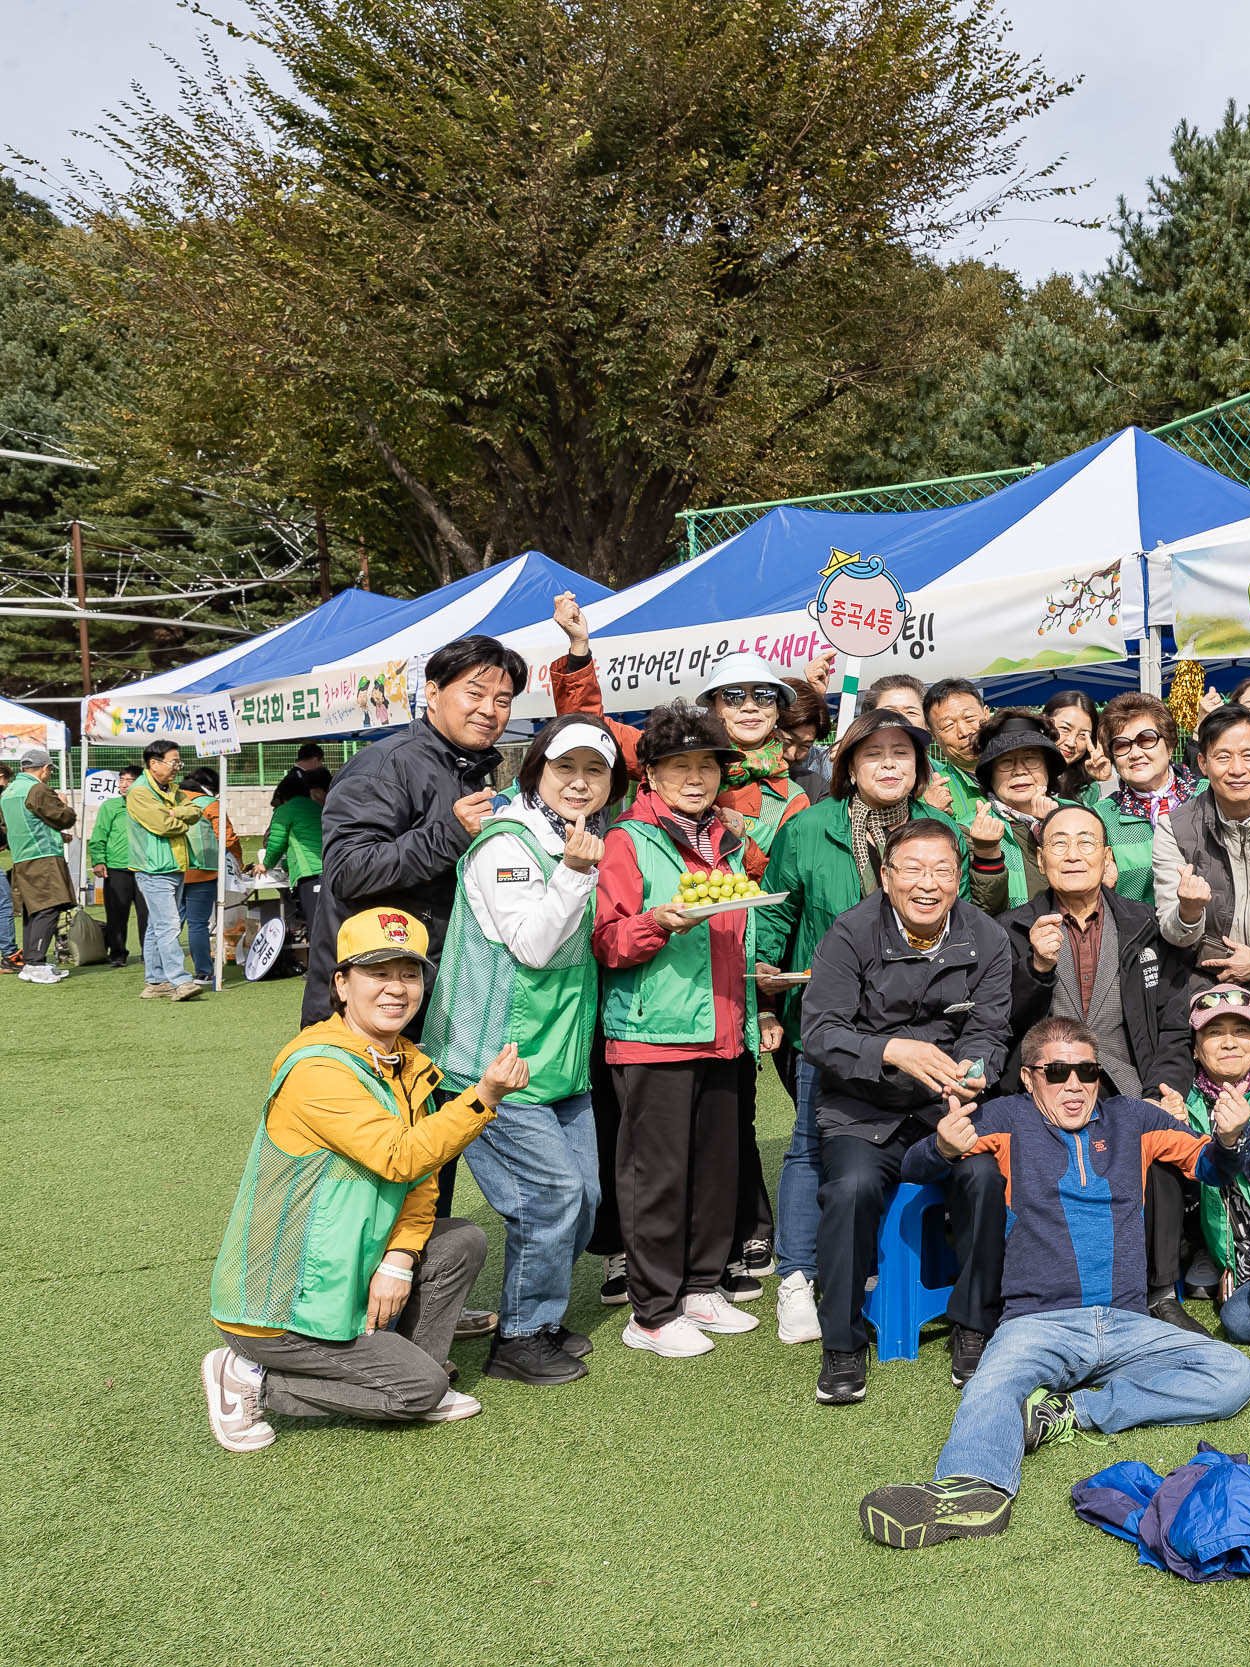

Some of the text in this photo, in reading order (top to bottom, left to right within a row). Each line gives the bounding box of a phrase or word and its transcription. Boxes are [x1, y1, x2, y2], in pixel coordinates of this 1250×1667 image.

[830, 599, 893, 636] 중곡4동
[606, 648, 685, 692] 정감어린
[124, 706, 160, 733] 군자동
[196, 710, 229, 734] 군자동
[90, 777, 121, 794] 군자
